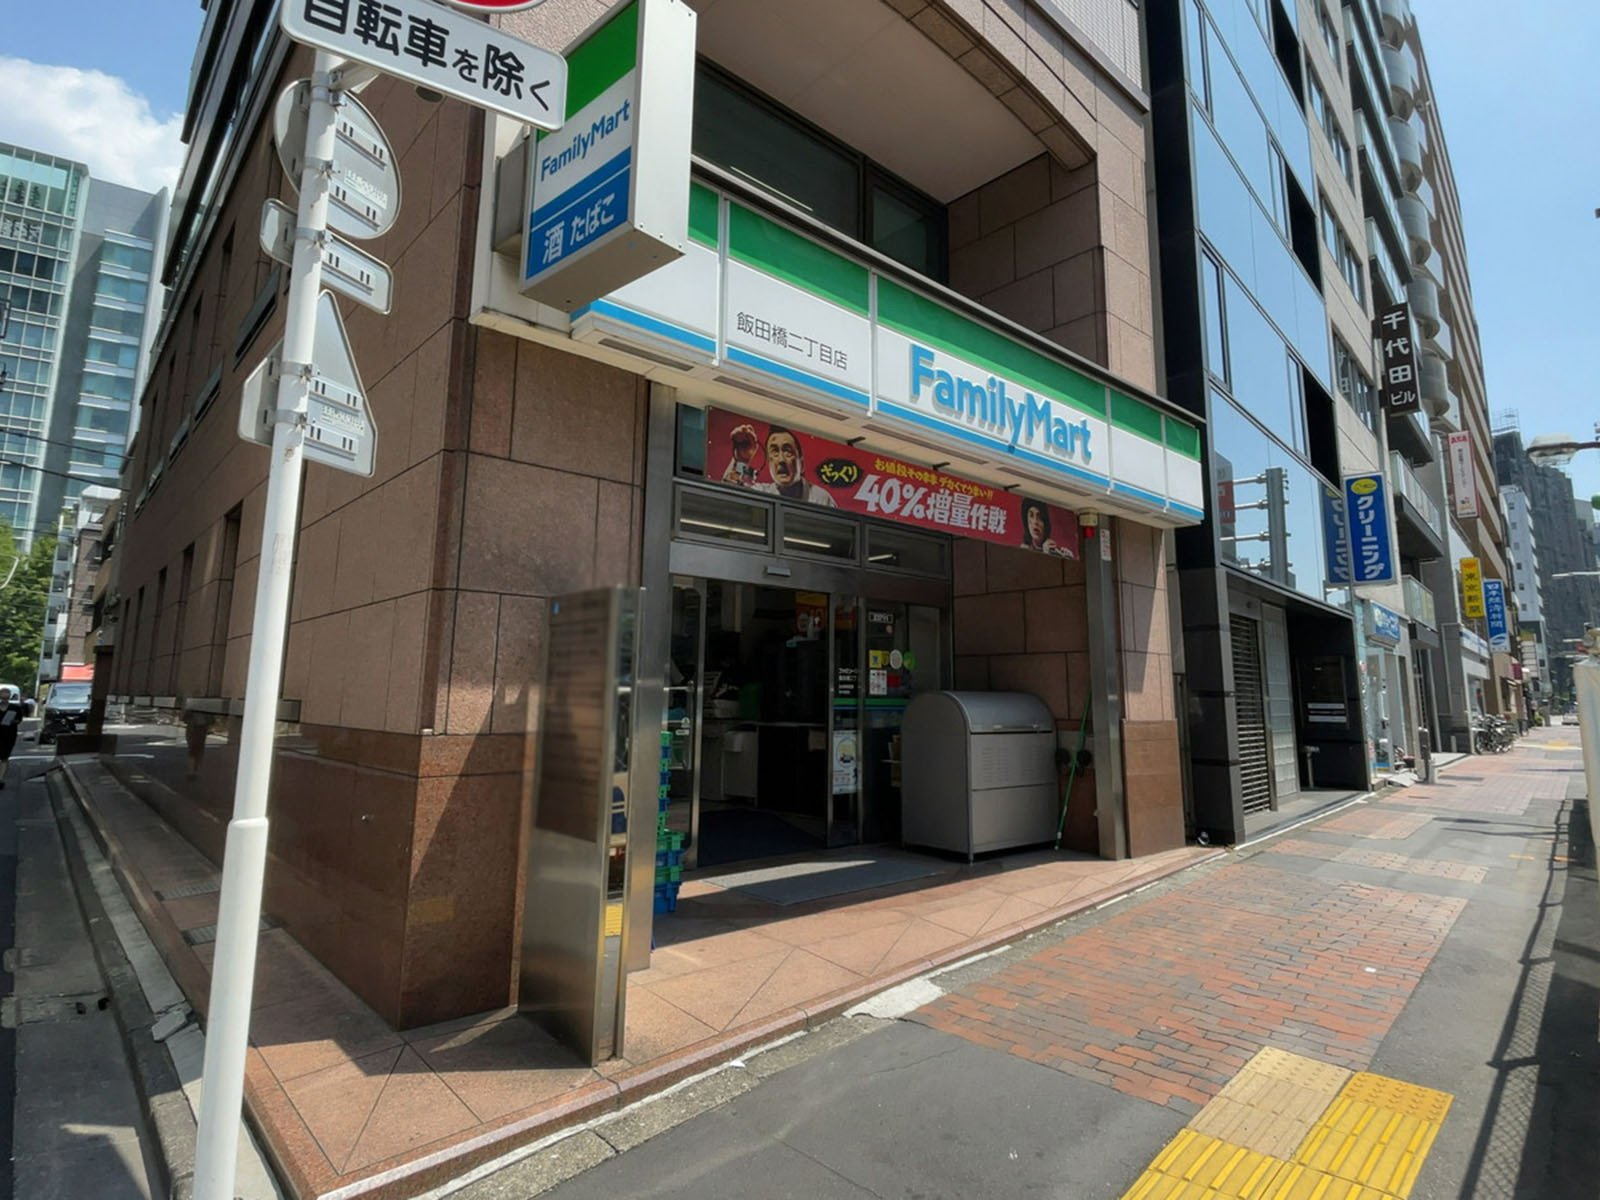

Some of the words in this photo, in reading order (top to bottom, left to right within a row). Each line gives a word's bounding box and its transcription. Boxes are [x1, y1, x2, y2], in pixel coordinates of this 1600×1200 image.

[303, 0, 550, 111] 自転車を除く
[541, 99, 630, 181] FamilyMart
[736, 311, 848, 370] 飯田橋二丁目店
[1382, 310, 1416, 405] 千代田ビル
[909, 343, 1092, 464] FamilyMart
[1357, 495, 1385, 580] クリーニング
